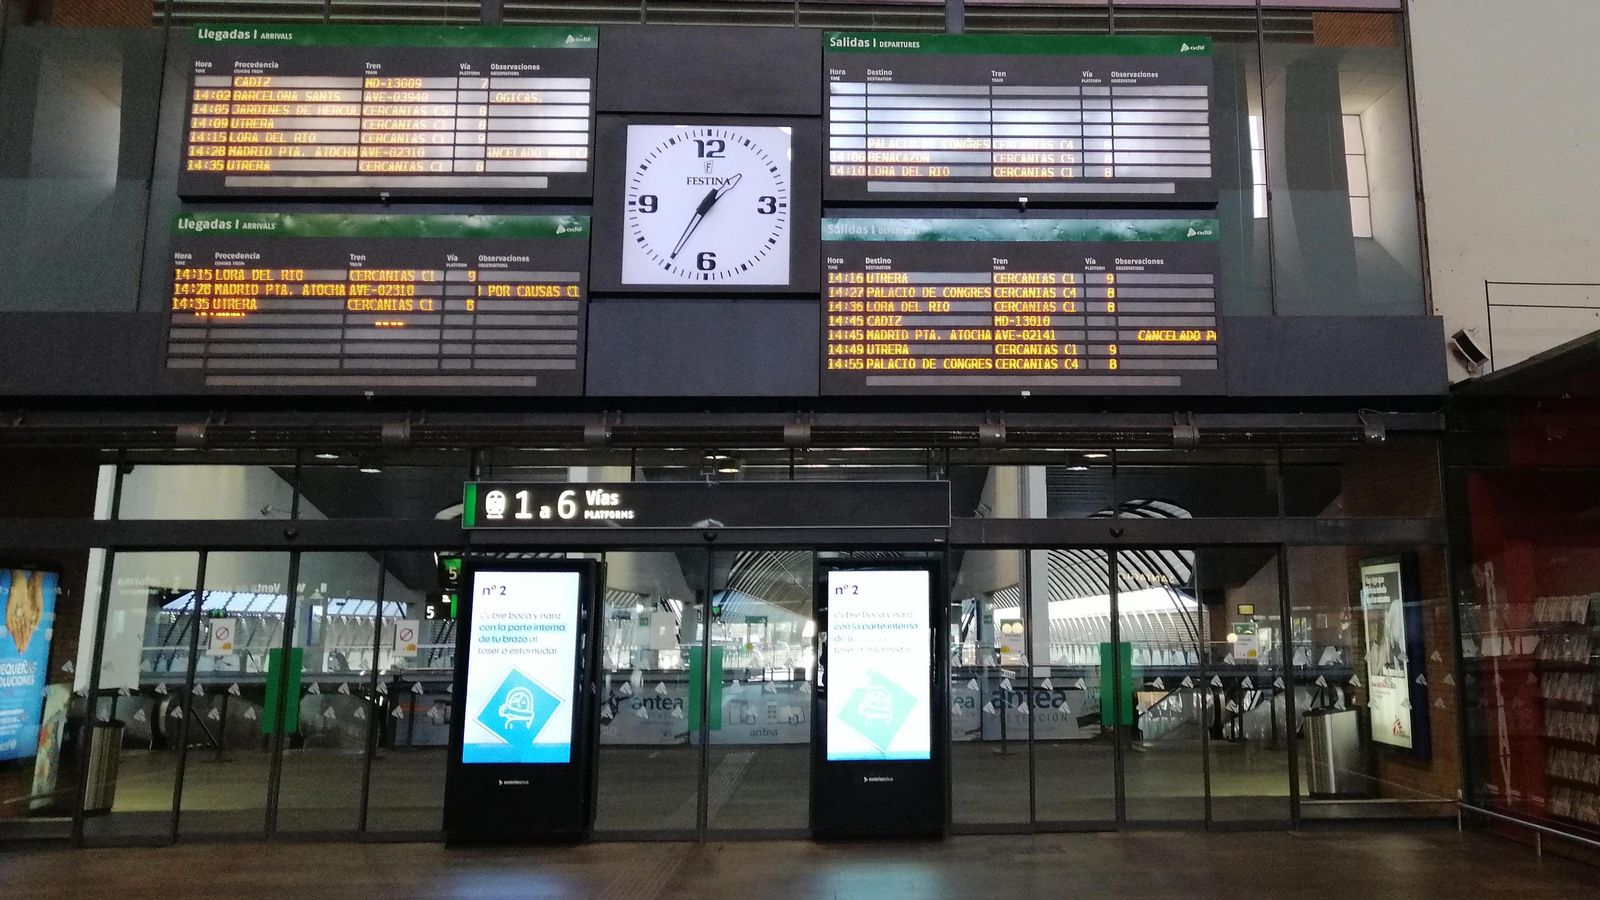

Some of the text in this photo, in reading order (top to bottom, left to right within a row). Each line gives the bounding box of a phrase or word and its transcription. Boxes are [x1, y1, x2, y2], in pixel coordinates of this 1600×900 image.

[198, 28, 292, 41] Llegadas ARRIVALS
[830, 38, 870, 48] Salidas
[234, 61, 278, 69] Procedencia
[1082, 70, 1093, 78] Vía
[234, 77, 488, 88] CADIZ 7
[194, 90, 342, 101] 14:02 BARCELONA SANTS
[192, 104, 230, 114] 14:05
[232, 104, 290, 115] JARDINES
[296, 104, 310, 115] DE
[363, 106, 428, 116] CERCANIAS
[192, 118, 228, 128] 14:09
[231, 118, 274, 128] UTRERA
[362, 119, 426, 129] CERCANIAS
[190, 132, 227, 142] 14:15
[229, 132, 258, 142] LORA
[266, 132, 286, 142] DEL
[294, 132, 316, 143] RIO
[362, 133, 425, 143] CERCANIAS
[693, 140, 726, 158] 12
[992, 140, 1053, 149] CERCANIAS
[228, 146, 272, 156] MADRID
[315, 146, 357, 157] ATOCHA
[868, 152, 1074, 163] BENACAZON CERCANIAS C5
[187, 160, 442, 171] 14:35 UTRERA CERCANIAS C1
[830, 165, 1073, 178] 14:10 LORA DEL RIO CERCANIAS C1
[686, 176, 730, 185] FESTINA
[638, 195, 658, 213] 9
[757, 196, 776, 214] 3
[178, 218, 275, 231] Llegadas ARRIVALS
[827, 224, 869, 234] Salidas
[175, 252, 192, 260] Hora
[215, 252, 260, 260] Procedencia
[447, 254, 458, 262] Vía
[478, 254, 530, 262] Observaciones
[697, 252, 716, 270] 6
[175, 269, 476, 282] 14:15 LORA DEL RIO CERCANIAS C1 9
[828, 273, 1114, 284] 14:16 UTRERA CERCANIAS C1 9
[174, 284, 560, 297] 14:28 MADRID PTA. ATOCHA AVE-02310 POR CAUSAS
[828, 287, 1115, 298] 14:27 PALACIO DE CONGRES CERCANIAS C4 8
[172, 298, 433, 310] 14:35 UTRERA CERCANIAS C1
[828, 301, 1076, 312] 14:36 LORA DEL RIO CERCANIAS C1
[828, 316, 1050, 326] 14:45 CADIZ MD-13010
[828, 330, 1201, 341] 14:45 MADRID PTA. ATOCHA AVE-02141 CANCELADO
[828, 344, 1117, 355] 14:49 UTRERA CERCANIAS C1 9
[828, 359, 1117, 369] 14:55 PALACIO DE CONGRES CERCANIAS C4 8
[585, 489, 619, 506] Vías
[515, 490, 576, 519] 1 a 6
[584, 510, 634, 519] PLATFORMS
[449, 567, 457, 580] 5
[500, 586, 506, 596] 2
[852, 585, 859, 594] 2
[426, 605, 435, 619] 5
[508, 624, 532, 634] parte
[479, 635, 490, 643] de
[502, 635, 528, 643] brazo
[632, 694, 683, 710] antea
[750, 729, 778, 737] antea
